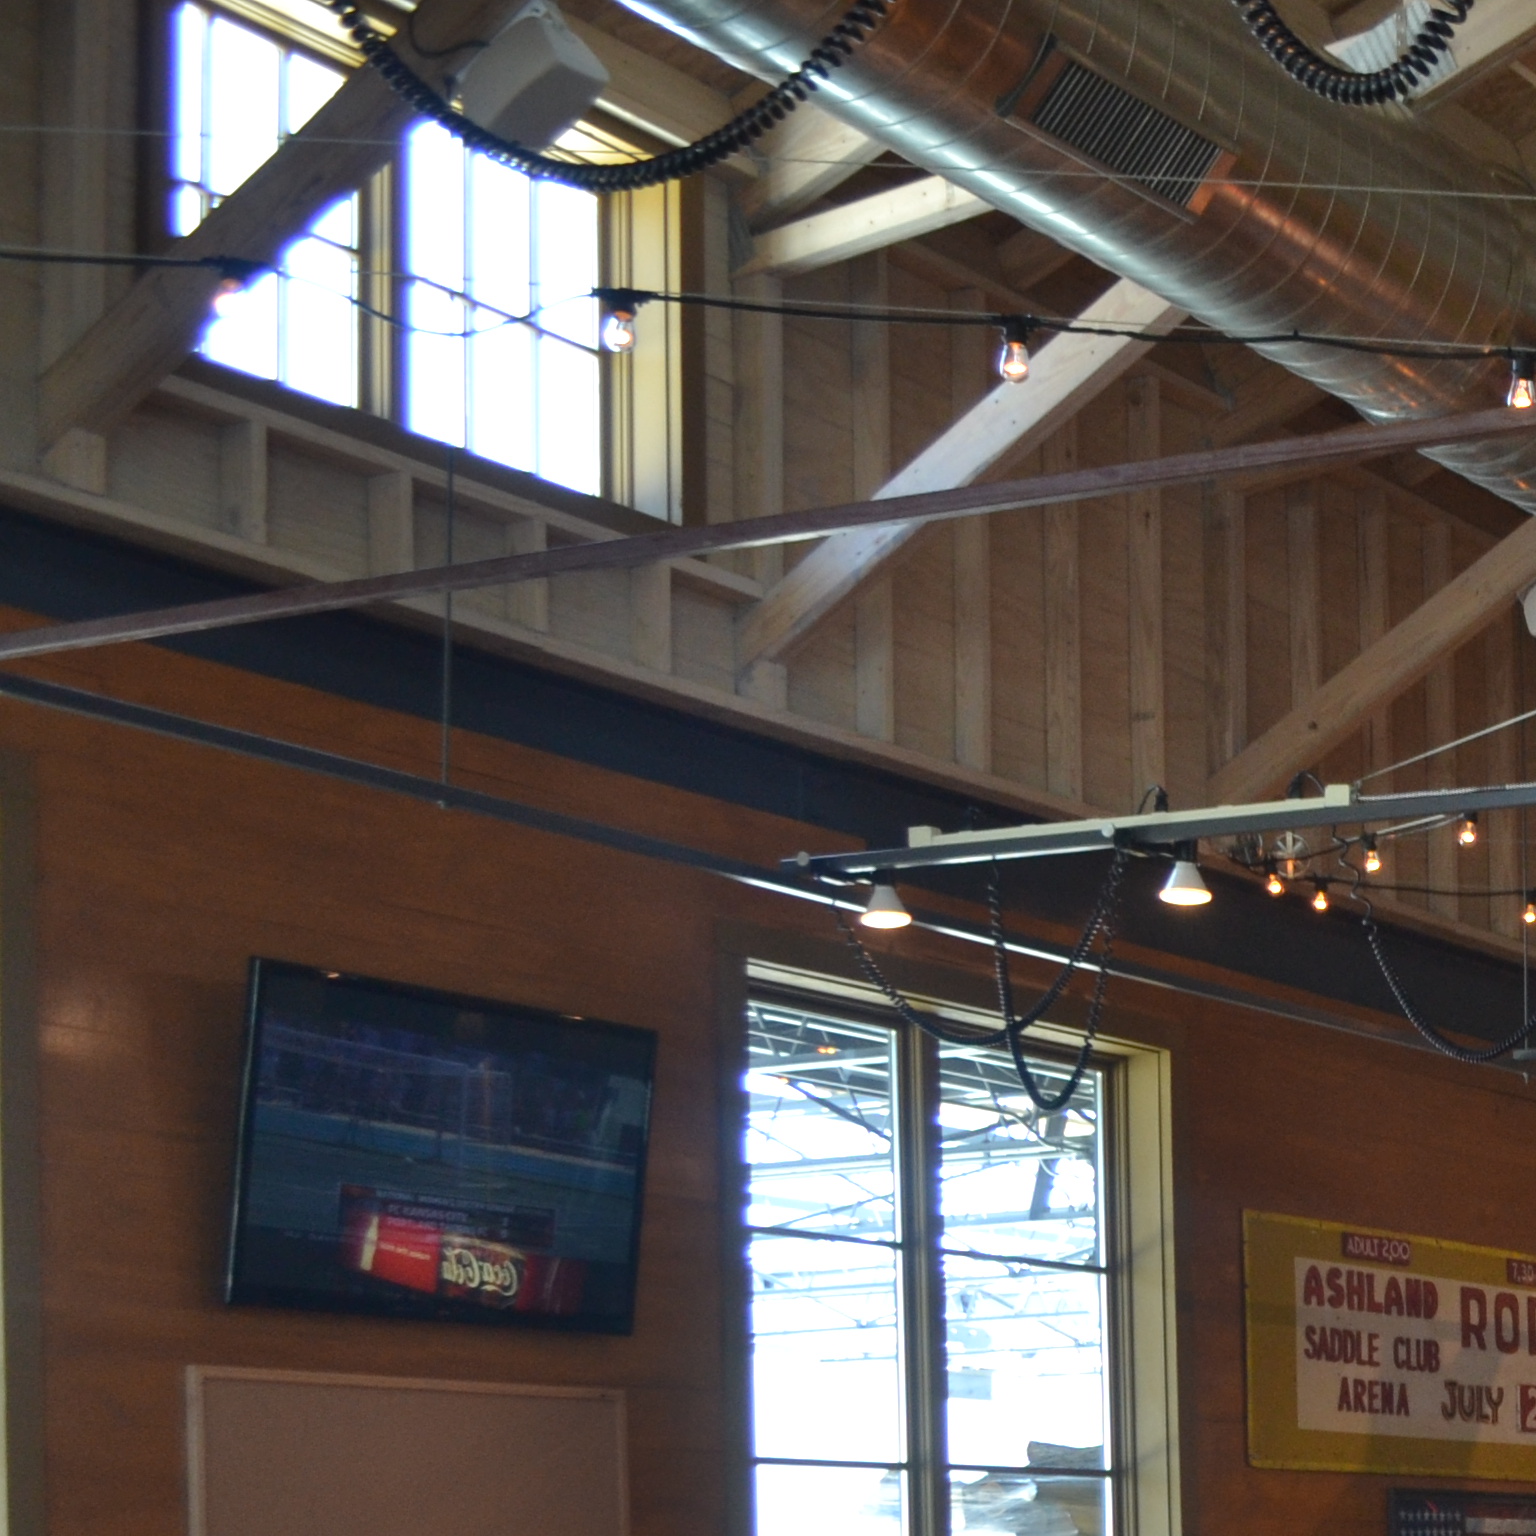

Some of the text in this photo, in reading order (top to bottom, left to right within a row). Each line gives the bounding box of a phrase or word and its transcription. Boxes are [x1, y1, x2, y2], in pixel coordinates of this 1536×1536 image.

[1347, 1236, 1378, 1257] ADULT
[1303, 1264, 1439, 1320] ASHLAND
[1303, 1324, 1440, 1374] SADDLE CLUB
[1337, 1376, 1410, 1418] ARENA
[1440, 1379, 1504, 1425] JULY
